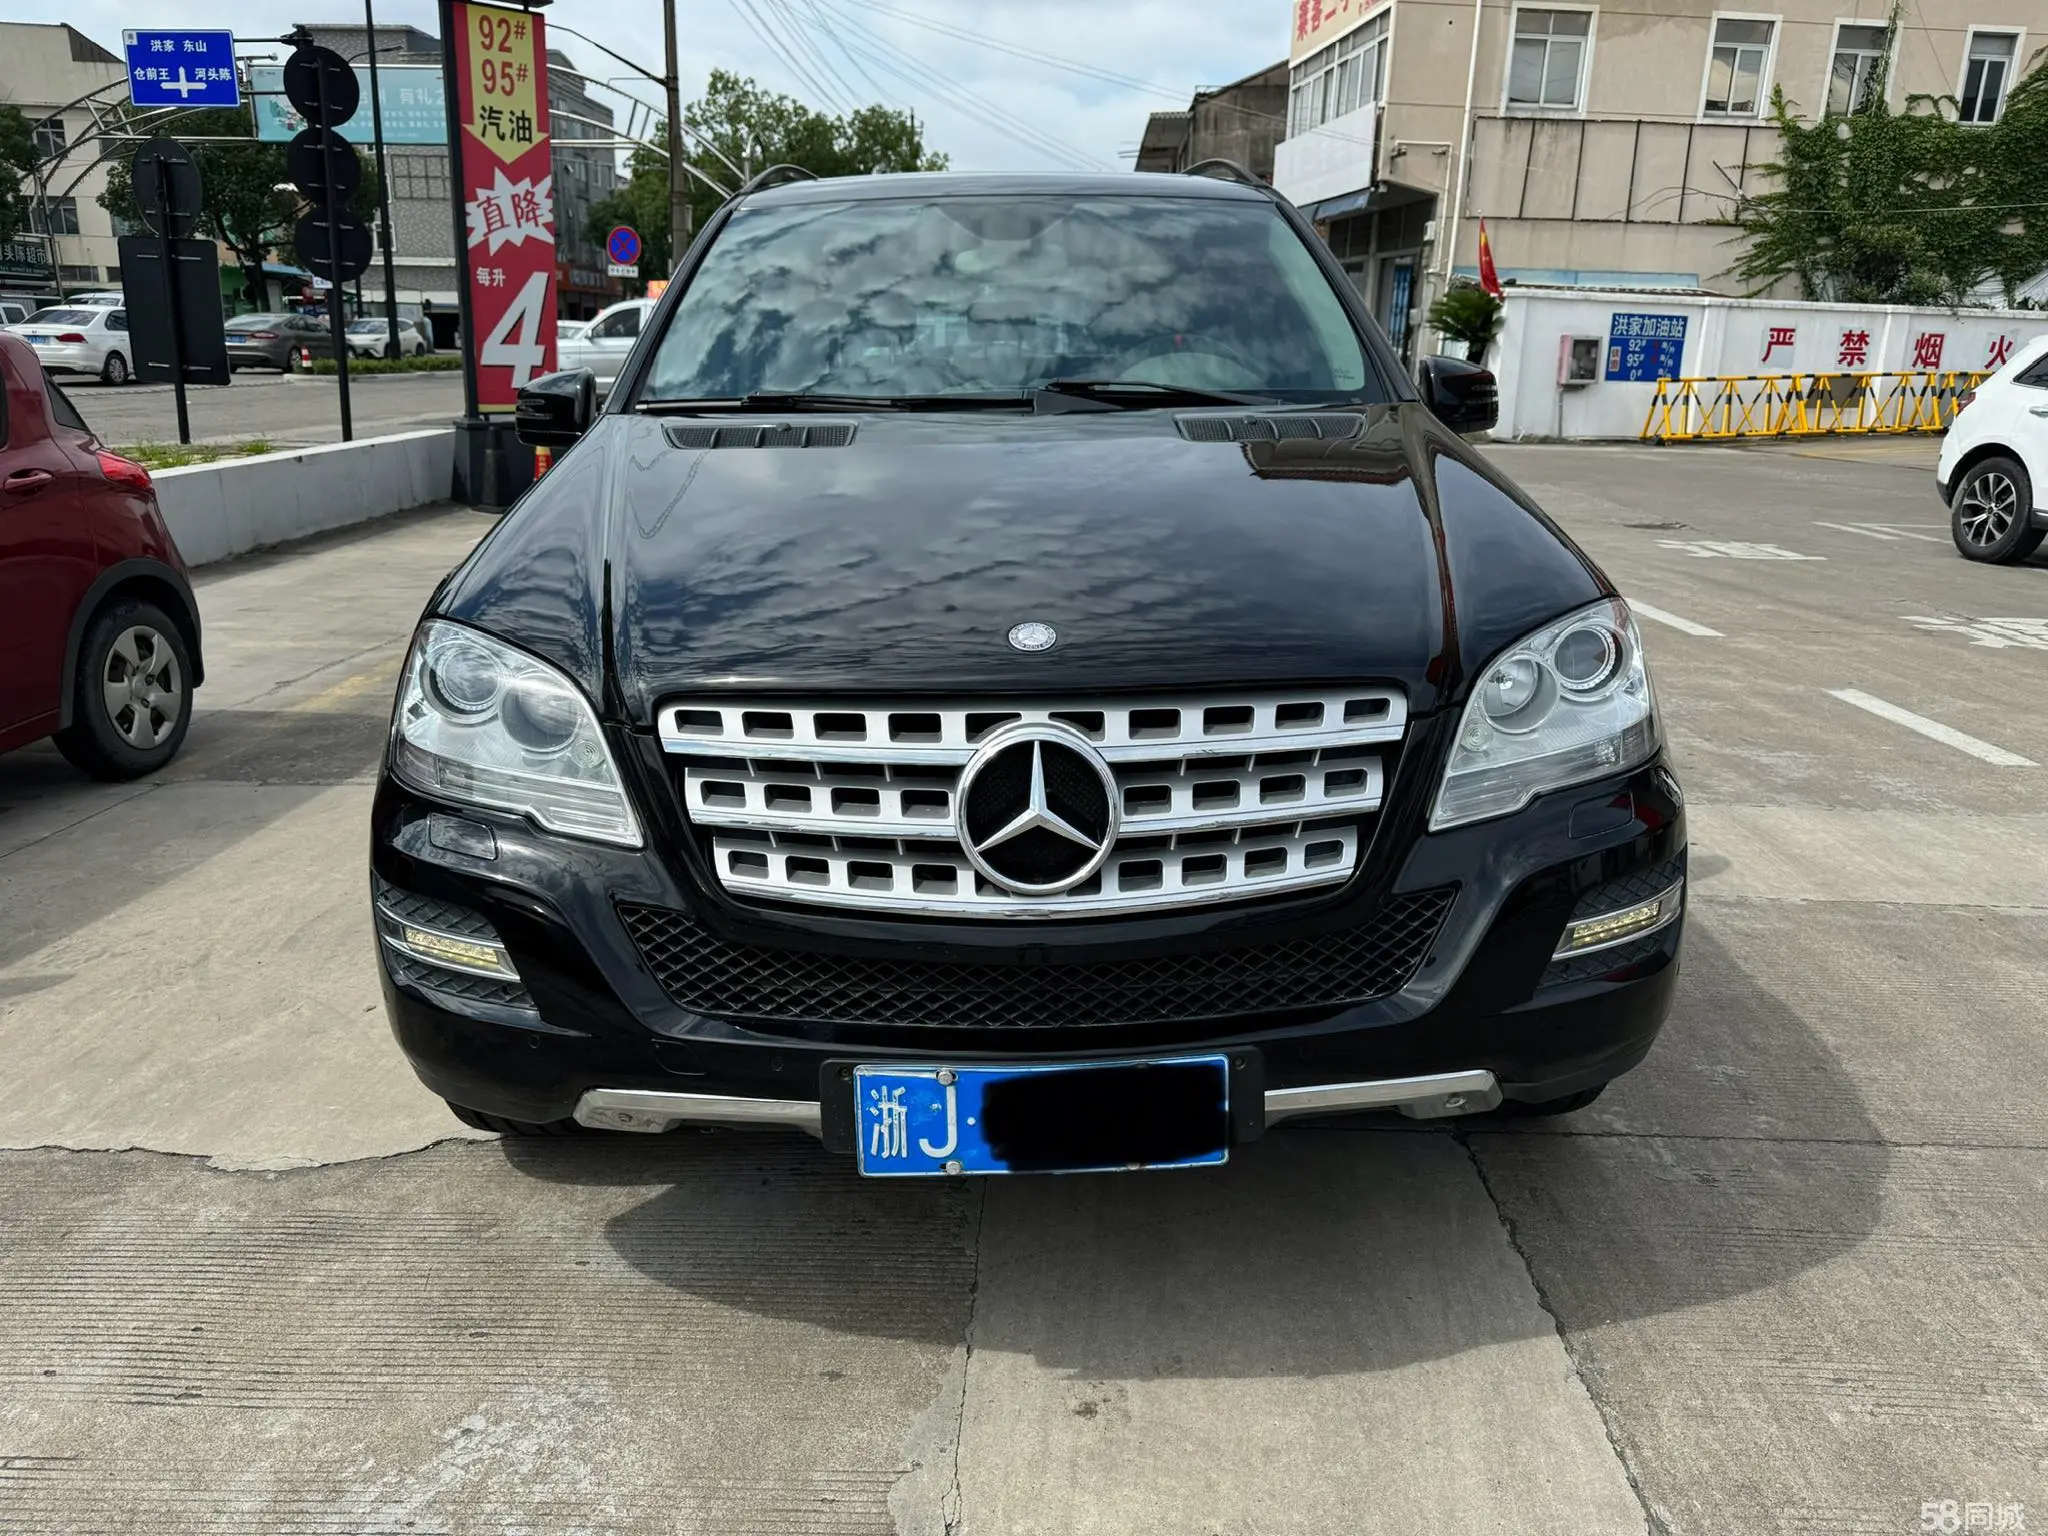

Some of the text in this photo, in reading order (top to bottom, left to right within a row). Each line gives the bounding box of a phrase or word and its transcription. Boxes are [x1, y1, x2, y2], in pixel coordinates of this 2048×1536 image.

[150, 40, 208, 53] 洪家 东山
[478, 14, 527, 53] 92#
[133, 67, 233, 81] 仓前王 河头陈
[481, 58, 529, 97] 95#
[480, 105, 533, 144] 汽油
[477, 189, 543, 238] 直降
[0, 243, 46, 264] 头陈超市
[476, 267, 506, 288] 每升
[480, 271, 550, 389] 4
[1613, 315, 1684, 337] 洪家加油站
[1762, 327, 2013, 369] 严禁烟火
